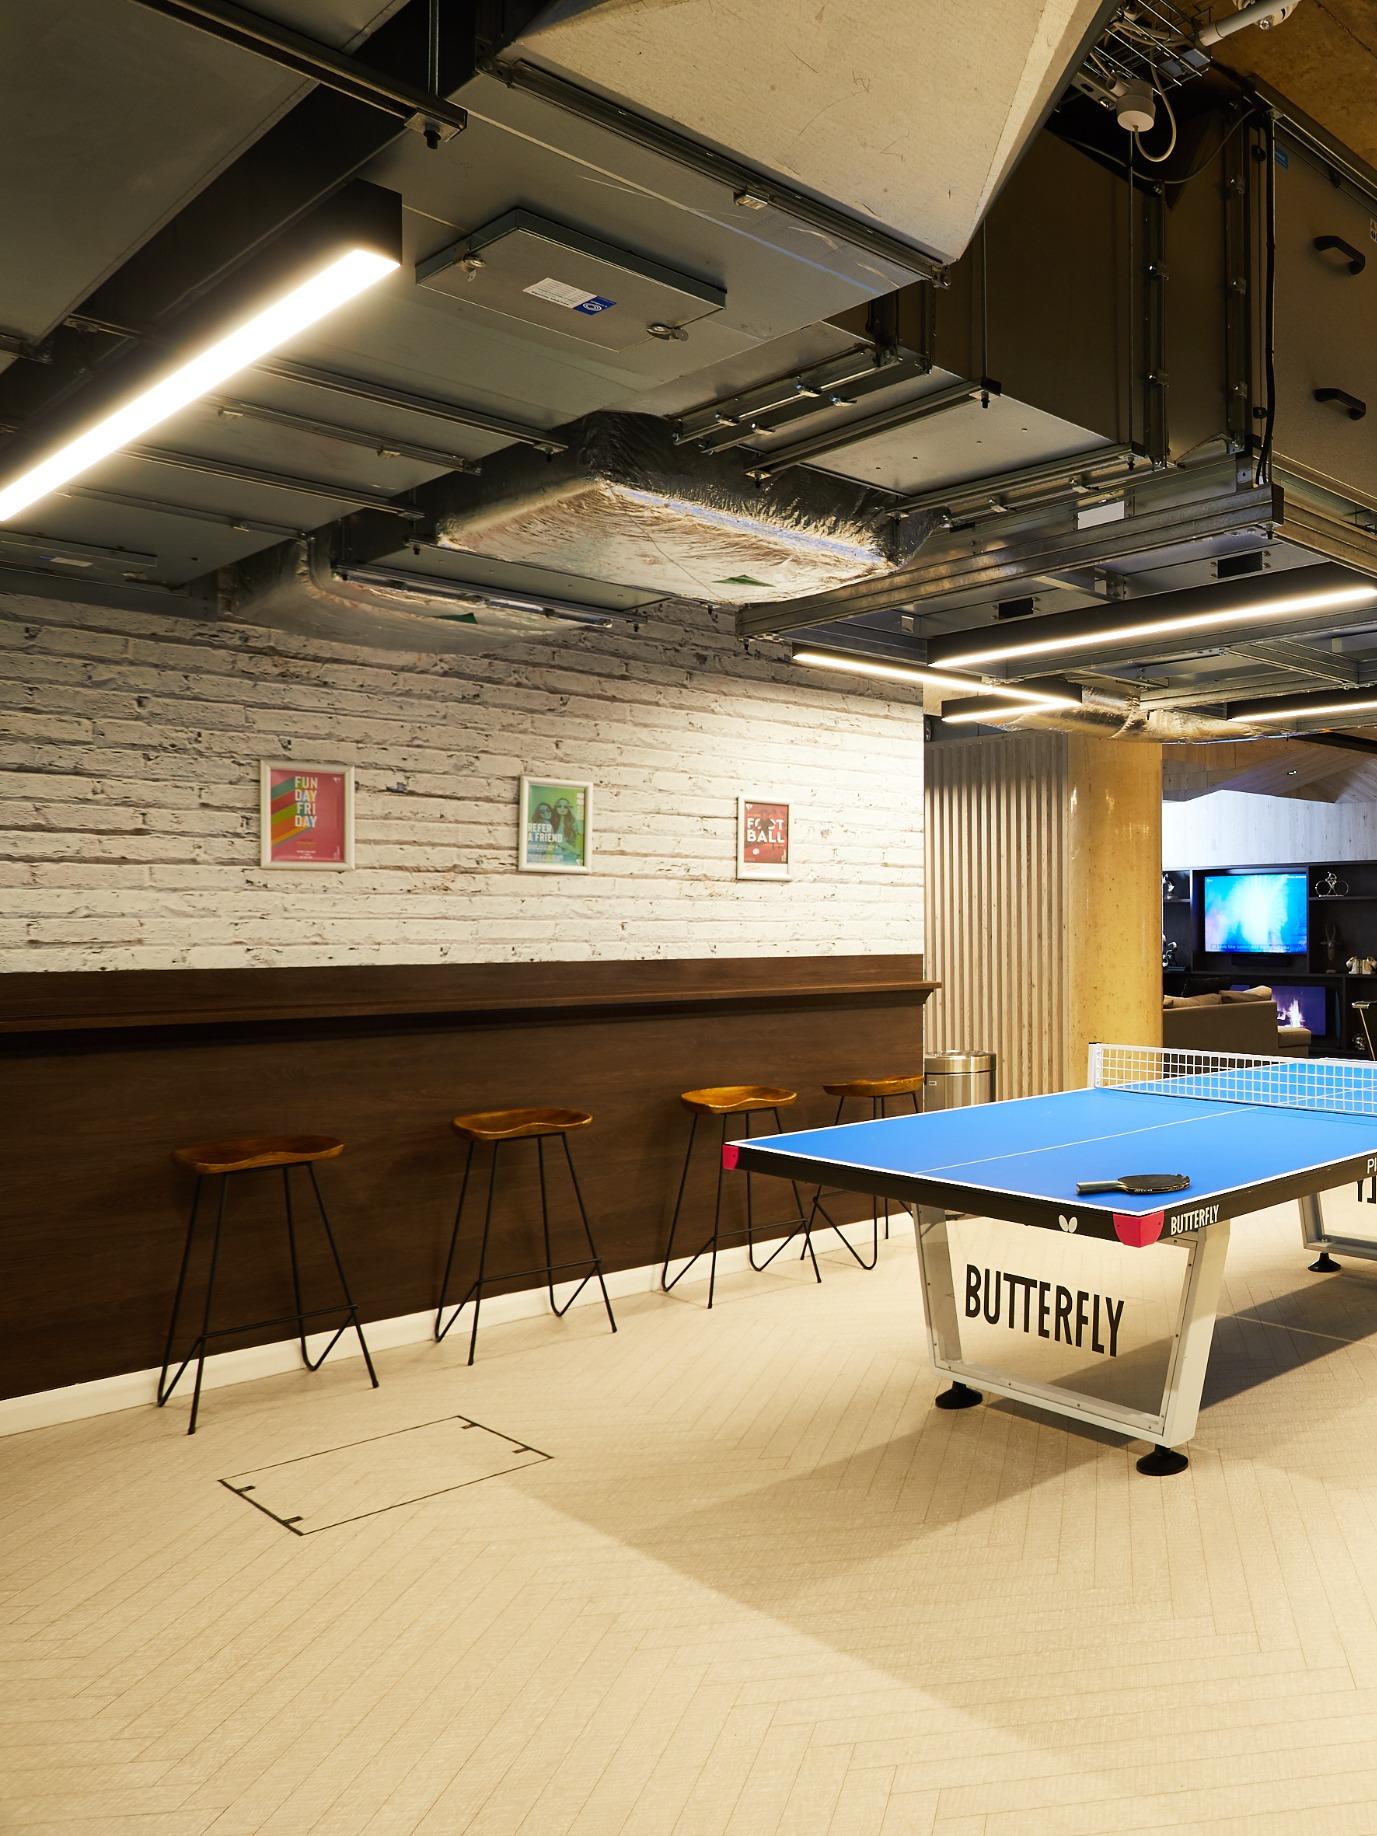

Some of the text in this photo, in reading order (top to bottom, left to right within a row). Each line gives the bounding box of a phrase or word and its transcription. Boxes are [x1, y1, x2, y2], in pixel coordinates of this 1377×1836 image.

[294, 776, 318, 789] FUN
[294, 789, 318, 802] DAY
[296, 802, 316, 815] FRI
[294, 815, 318, 828] DAY
[535, 833, 563, 843] FRIEND
[746, 830, 785, 843] BALL
[1170, 1204, 1220, 1236] BUTTERFLY
[965, 1263, 1125, 1358] BUTTERFLY
